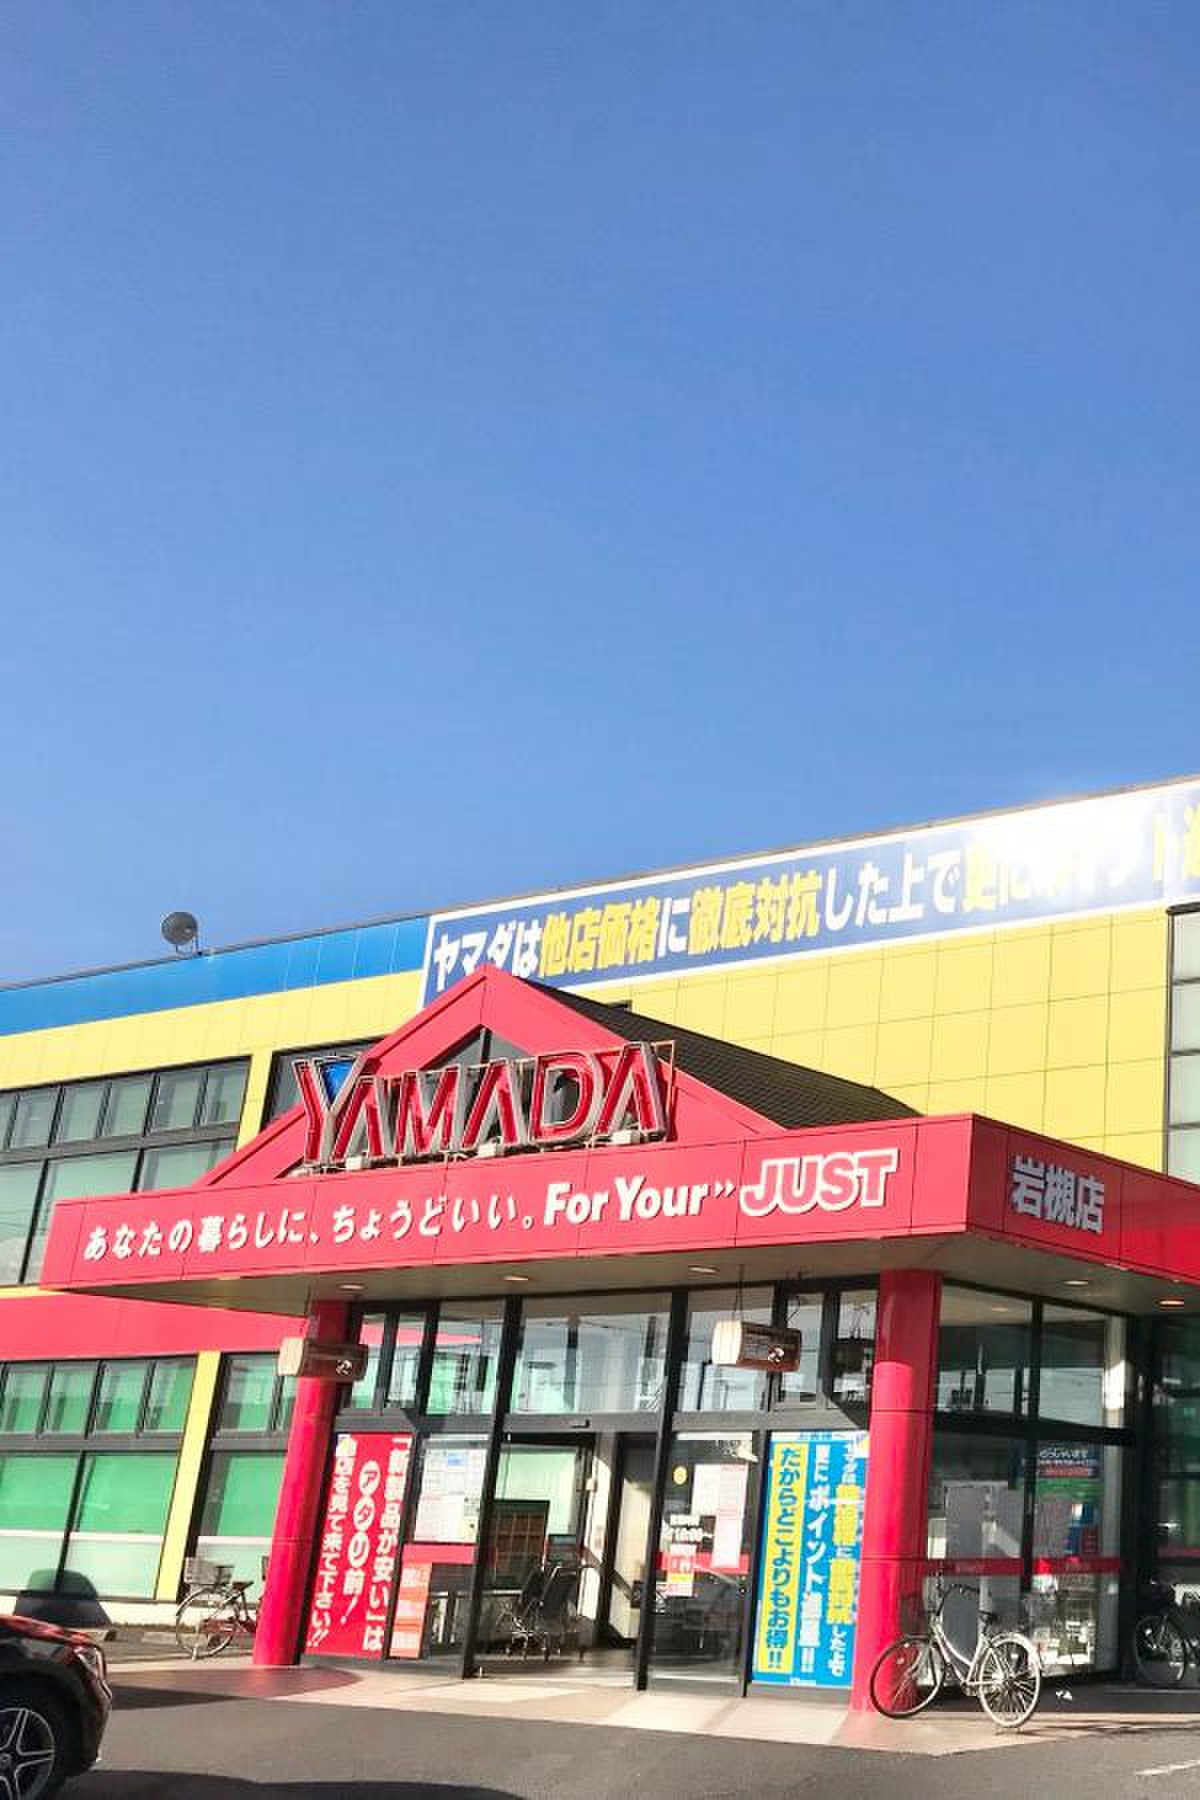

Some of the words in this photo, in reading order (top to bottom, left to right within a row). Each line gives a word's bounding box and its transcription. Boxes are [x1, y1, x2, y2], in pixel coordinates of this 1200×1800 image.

[293, 1041, 669, 1168] YAMADA
[83, 1199, 533, 1262] あなたの暮らしに、ちょうどいい。
[543, 1182, 609, 1227] For
[739, 1147, 899, 1217] JUST
[1009, 1154, 1105, 1235] 岩槻店
[306, 1434, 358, 1648] を見て来て下さい!!
